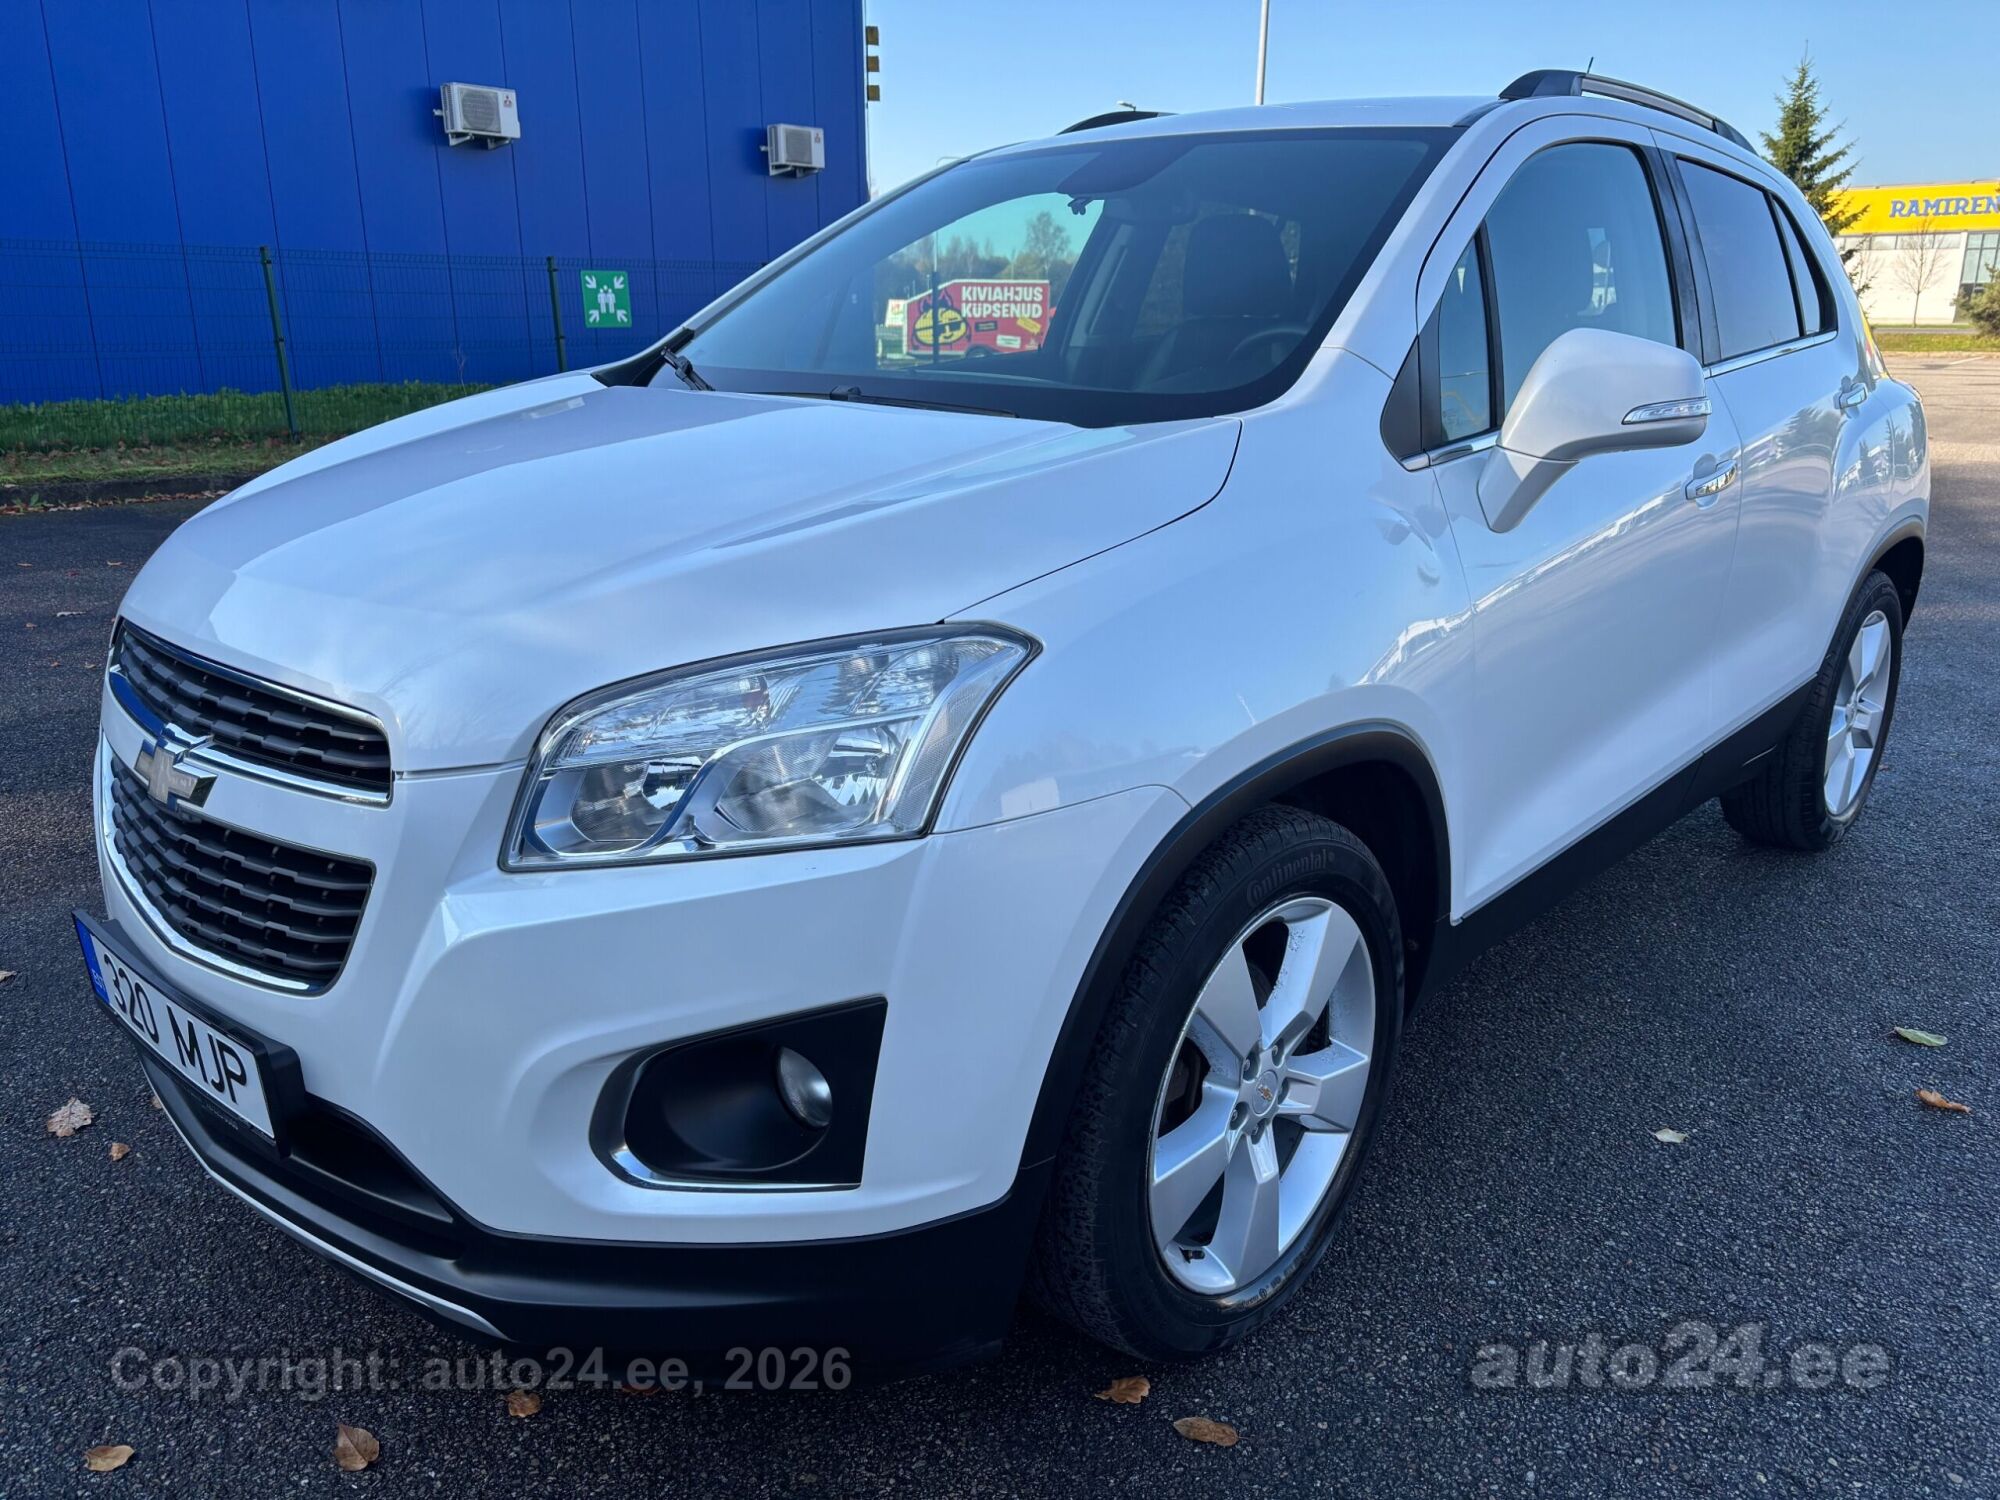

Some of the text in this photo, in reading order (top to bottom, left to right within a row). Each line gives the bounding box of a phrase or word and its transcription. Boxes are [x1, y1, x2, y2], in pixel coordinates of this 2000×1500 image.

[961, 286, 1043, 301] KIVIAHJUS
[961, 302, 1043, 318] KÜPSENUD
[1246, 849, 1327, 903] Continental
[103, 953, 248, 1104] 320 MJP
